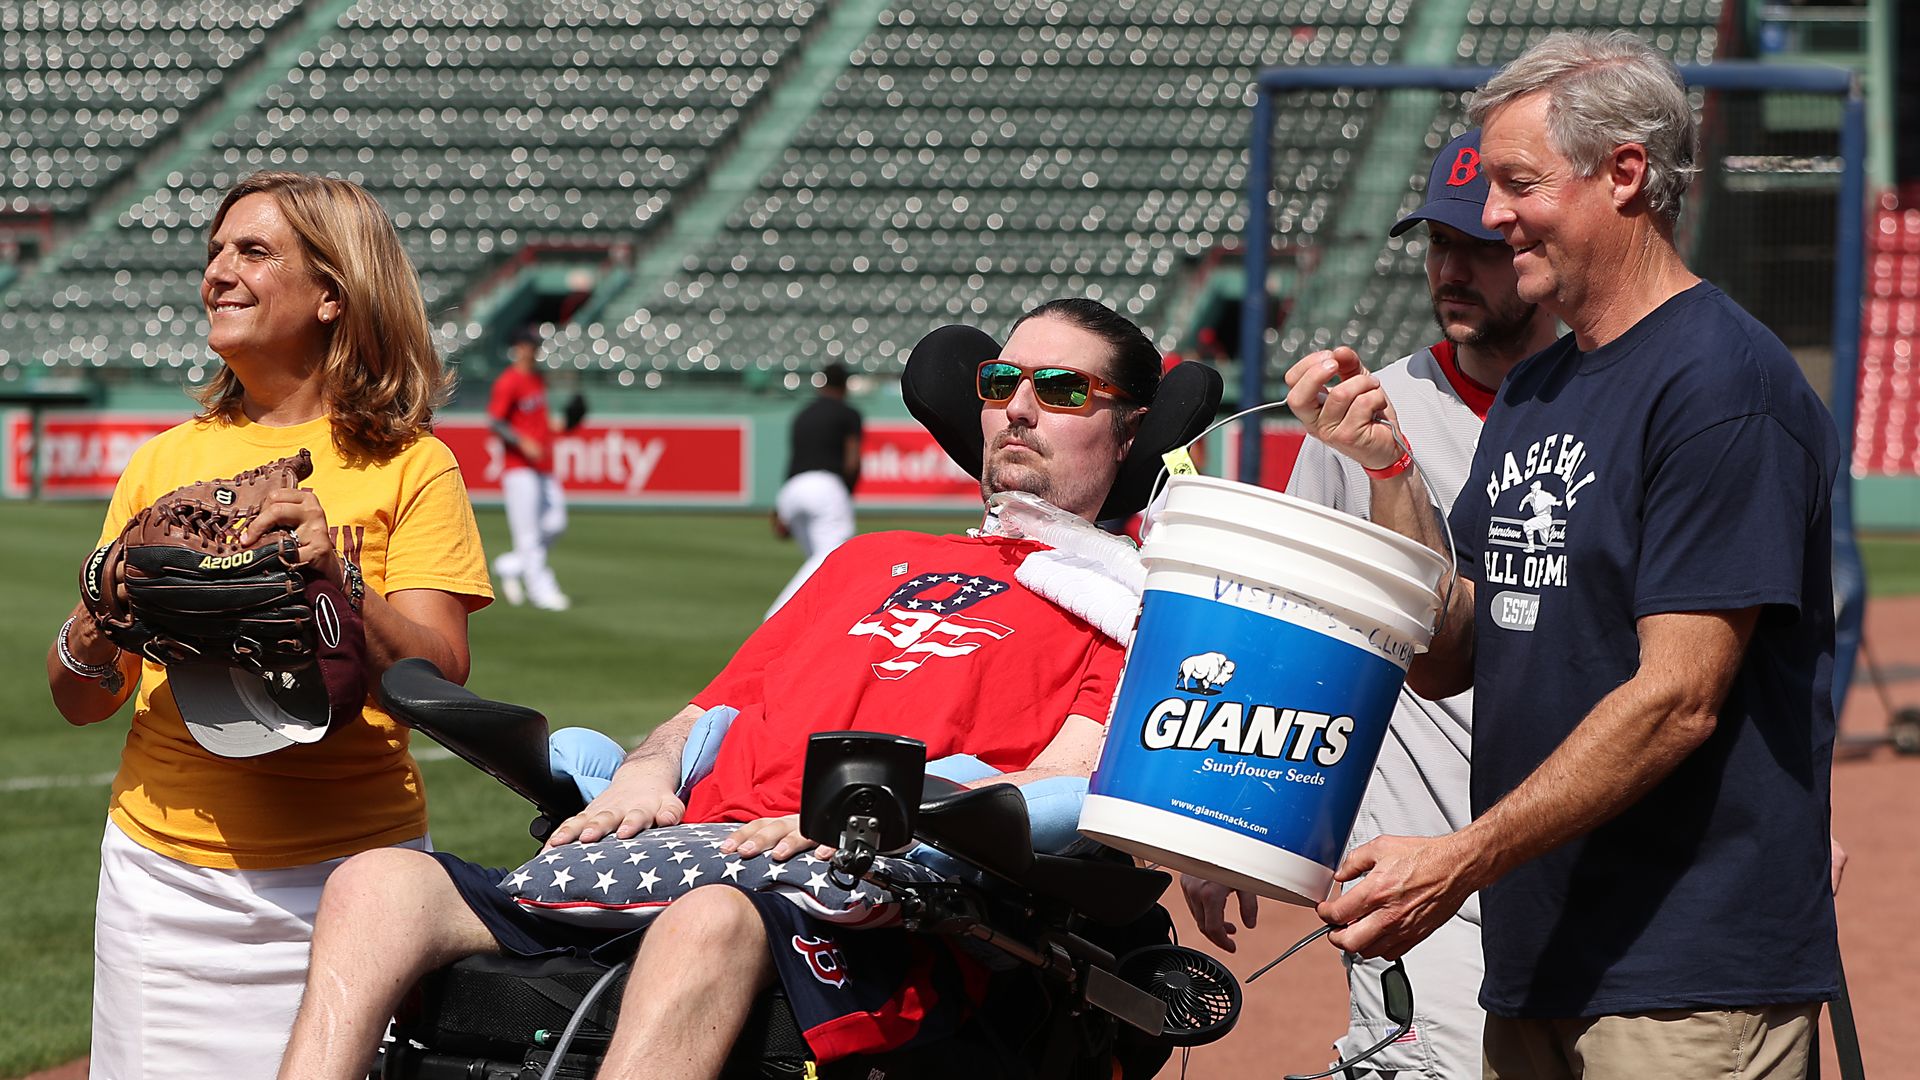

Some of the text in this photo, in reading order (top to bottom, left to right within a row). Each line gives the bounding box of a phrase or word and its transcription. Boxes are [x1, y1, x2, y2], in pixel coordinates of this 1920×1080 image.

[1446, 147, 1481, 187] B
[199, 550, 255, 570] A2000
[1141, 696, 1355, 768] GIANTS
[1201, 757, 1326, 786] Sunflower Seeds
[1170, 797, 1269, 836] www.giantsnacks.com
